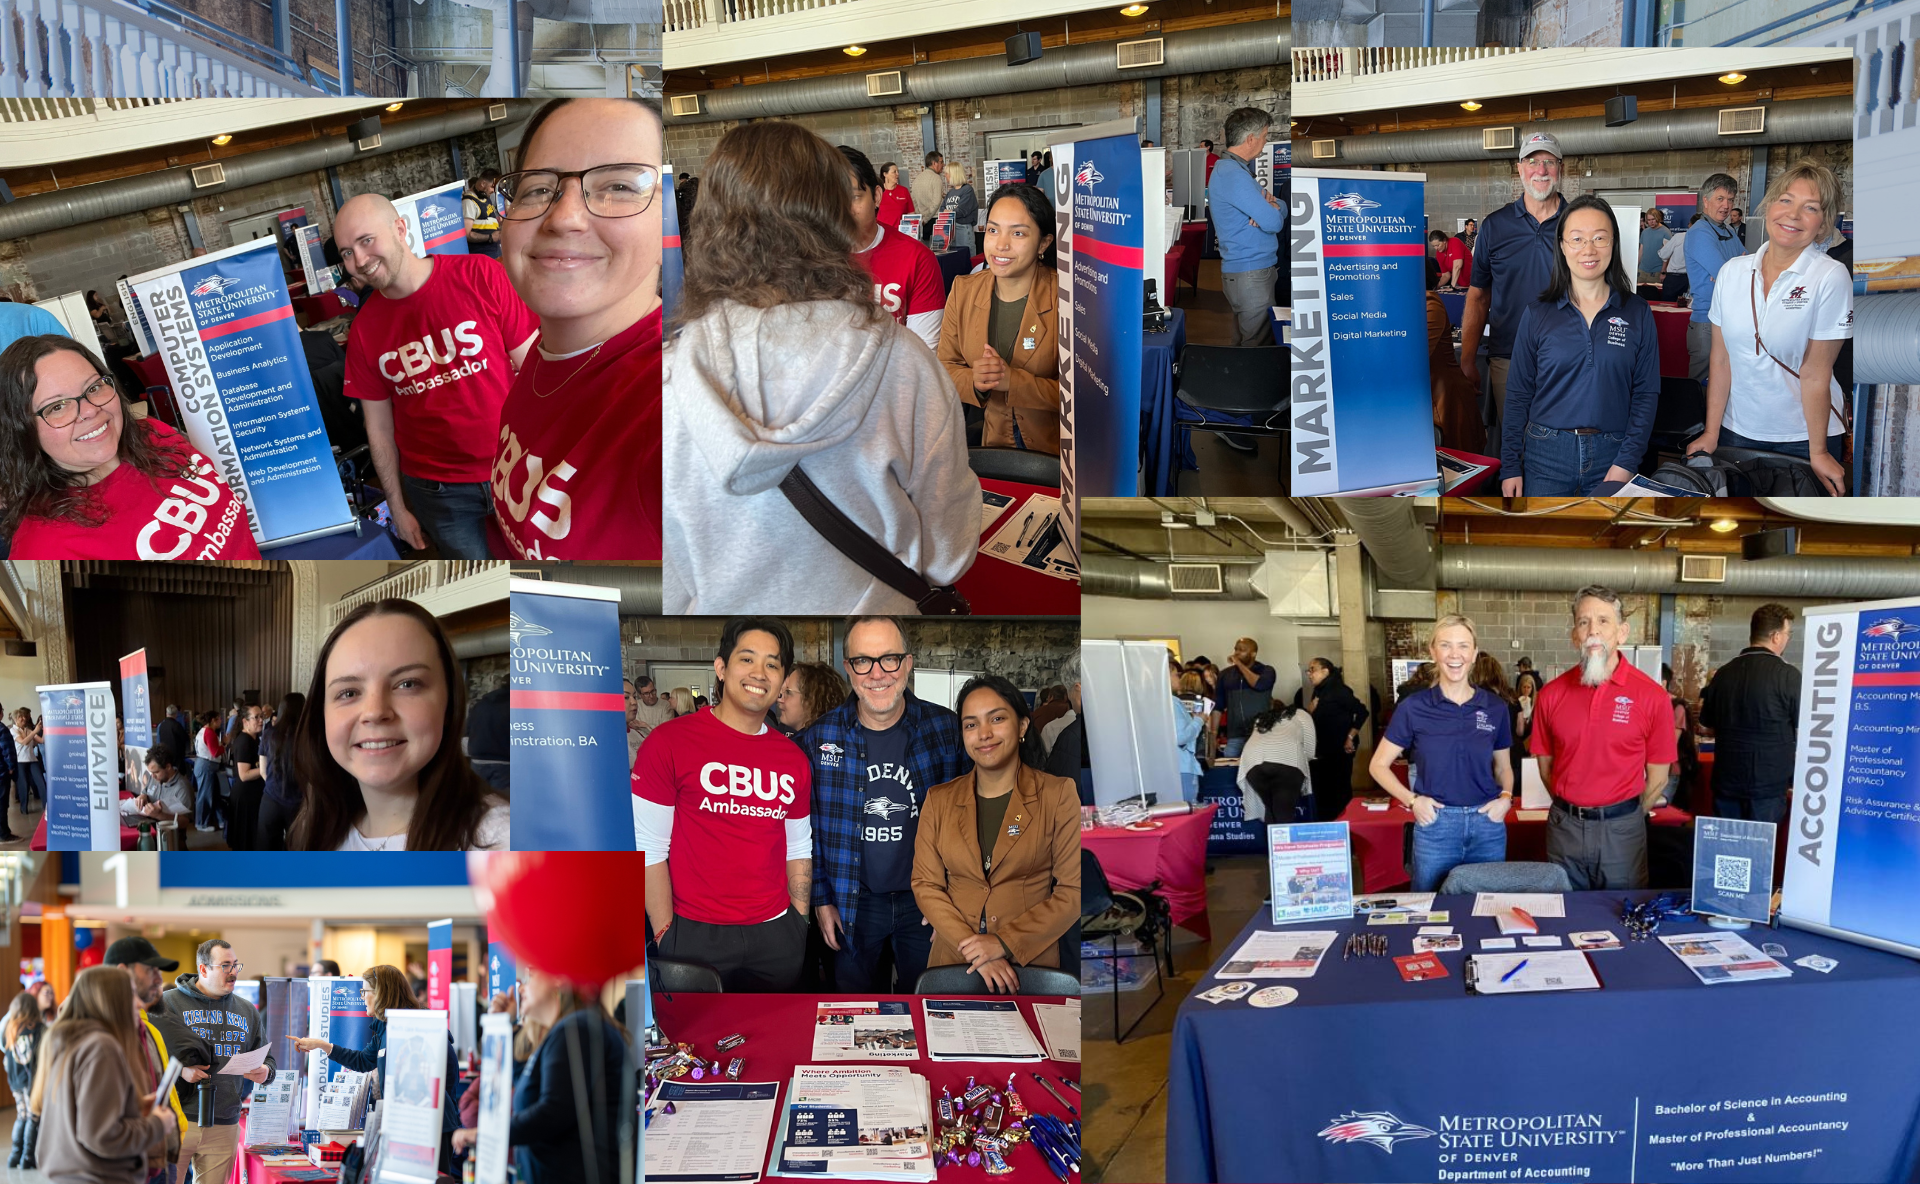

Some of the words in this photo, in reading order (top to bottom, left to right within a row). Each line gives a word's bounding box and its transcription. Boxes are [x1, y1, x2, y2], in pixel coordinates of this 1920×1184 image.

[1257, 151, 1268, 189] OPHY
[1075, 193, 1119, 210] METROPOLITAN
[422, 212, 458, 228] METROPOLITAN
[1075, 207, 1089, 219] STATE
[1090, 208, 1126, 226] UNIVERSITY
[1326, 214, 1406, 224] METROPOLITAN
[423, 226, 436, 234] STATE
[436, 217, 461, 230] UNIVERSITY
[1081, 223, 1094, 232] DENVER
[1326, 224, 1354, 233] STATE
[1356, 224, 1413, 233] UNIVERSITY
[1074, 260, 1098, 283] Advertising
[1098, 272, 1108, 284] and
[1329, 263, 1380, 272] Advertising
[1382, 262, 1398, 270] and
[1074, 274, 1097, 294] Promotions
[1330, 273, 1380, 281] Promotions
[119, 284, 138, 326] ENGLISH
[194, 284, 267, 310] METROPOLITAN
[198, 306, 222, 319] STATE
[223, 291, 276, 312] UNIVERSITY
[1330, 293, 1354, 301] Sales
[1075, 301, 1086, 316] Sales
[1332, 312, 1358, 320] Social
[211, 312, 235, 324] DENVER
[166, 285, 211, 390] SYSTEMS
[1291, 192, 1332, 475] MARKETING
[1333, 332, 1362, 340] Digital
[1364, 330, 1406, 338] Marketing
[1610, 326, 1626, 334] MSU
[208, 336, 254, 353] Application
[1056, 163, 1074, 525] MARKETING
[1075, 326, 1087, 345] Social
[1087, 338, 1098, 355] Media
[150, 291, 200, 414] COMPUTER
[210, 342, 263, 362] Development
[378, 320, 484, 383] CBUS
[216, 365, 250, 380] Business
[252, 354, 288, 370] Analytics
[1076, 353, 1088, 372] Digital
[1088, 366, 1109, 396] Marketing
[394, 357, 488, 396] Ambassador
[222, 382, 258, 396] Database
[224, 388, 276, 405] Development
[277, 382, 292, 391] and
[228, 394, 284, 414] Administration
[232, 414, 276, 430] Information
[278, 404, 310, 420] Systems
[235, 424, 266, 438] Security
[240, 441, 272, 454] Network
[274, 434, 306, 448] Systems
[308, 428, 322, 438] and
[244, 444, 298, 462] Administration
[248, 468, 266, 478] Web
[268, 456, 318, 474] Development
[250, 476, 266, 486] and
[266, 464, 322, 482] Administration
[136, 453, 228, 560] CBUS
[1860, 641, 1920, 652] METROPOL
[1860, 652, 1888, 661] STATE
[1890, 650, 1920, 660] UNIV
[514, 660, 605, 676] UNIVERSITY
[1856, 692, 1908, 701] Accounting
[1852, 724, 1904, 734] Accounting
[578, 736, 598, 746] BA
[1798, 622, 1843, 867] ACCOUNTING
[1850, 744, 1880, 754] Master
[1882, 746, 1892, 754] of
[820, 760, 840, 768] DENVER
[821, 753, 840, 763] MSU
[1849, 755, 1902, 766] Professional
[1848, 766, 1906, 778] Accountancy
[699, 762, 796, 805] CBUS
[1847, 776, 1885, 787] (MPAcc)
[1845, 796, 1864, 805] Risk
[1865, 798, 1911, 810] Assurance
[1844, 806, 1883, 818] Advisory
[1226, 832, 1255, 840] Studies
[102, 852, 128, 909] 1
[1718, 890, 1734, 898] SCAN
[1735, 892, 1745, 900] ME
[321, 986, 330, 1038] STUDIES
[183, 1010, 222, 1026] KISLING
[226, 1010, 249, 1033] NCOA
[192, 1026, 216, 1040] EST.
[220, 1030, 246, 1042] 1975
[1655, 1104, 1706, 1115] Bachelor
[1709, 1102, 1722, 1112] of
[1724, 1098, 1768, 1110] Science
[1770, 1096, 1781, 1106] in
[1784, 1092, 1848, 1104] Accounting
[1439, 1114, 1602, 1132] METROPOLITAN
[1746, 1113, 1756, 1122] &
[1438, 1132, 1494, 1149] STATE
[1500, 1130, 1618, 1148] UNIVERSITY
[1649, 1134, 1687, 1144] Master
[1690, 1132, 1702, 1142] of
[1704, 1126, 1774, 1140] Professional
[1778, 1120, 1849, 1134] Accountancy
[1438, 1154, 1458, 1163] OF
[1464, 1152, 1518, 1163] DENVER
[1670, 1160, 1704, 1172] "More
[1706, 1158, 1735, 1169] Than
[1738, 1156, 1762, 1166] Just
[1764, 1148, 1823, 1163] Numbers!"
[1438, 1168, 1508, 1182] Department
[1510, 1168, 1522, 1178] of
[1524, 1165, 1590, 1178] Accounting
